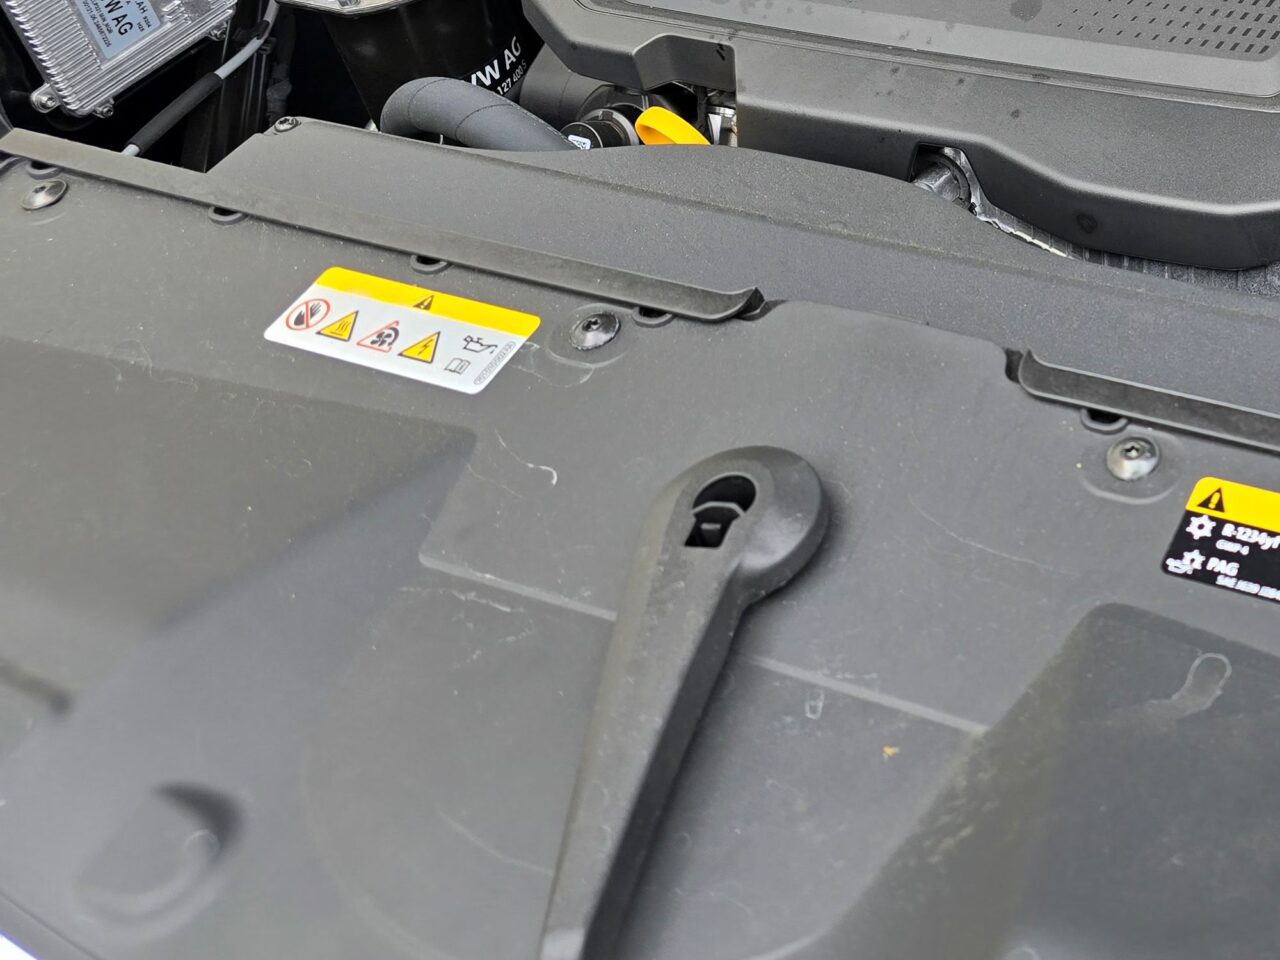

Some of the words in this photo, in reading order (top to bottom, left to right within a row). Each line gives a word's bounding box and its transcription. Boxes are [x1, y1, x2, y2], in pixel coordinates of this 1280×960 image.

[111, 13, 133, 36] AG
[497, 77, 512, 95] 127
[1206, 557, 1240, 577] PAG
